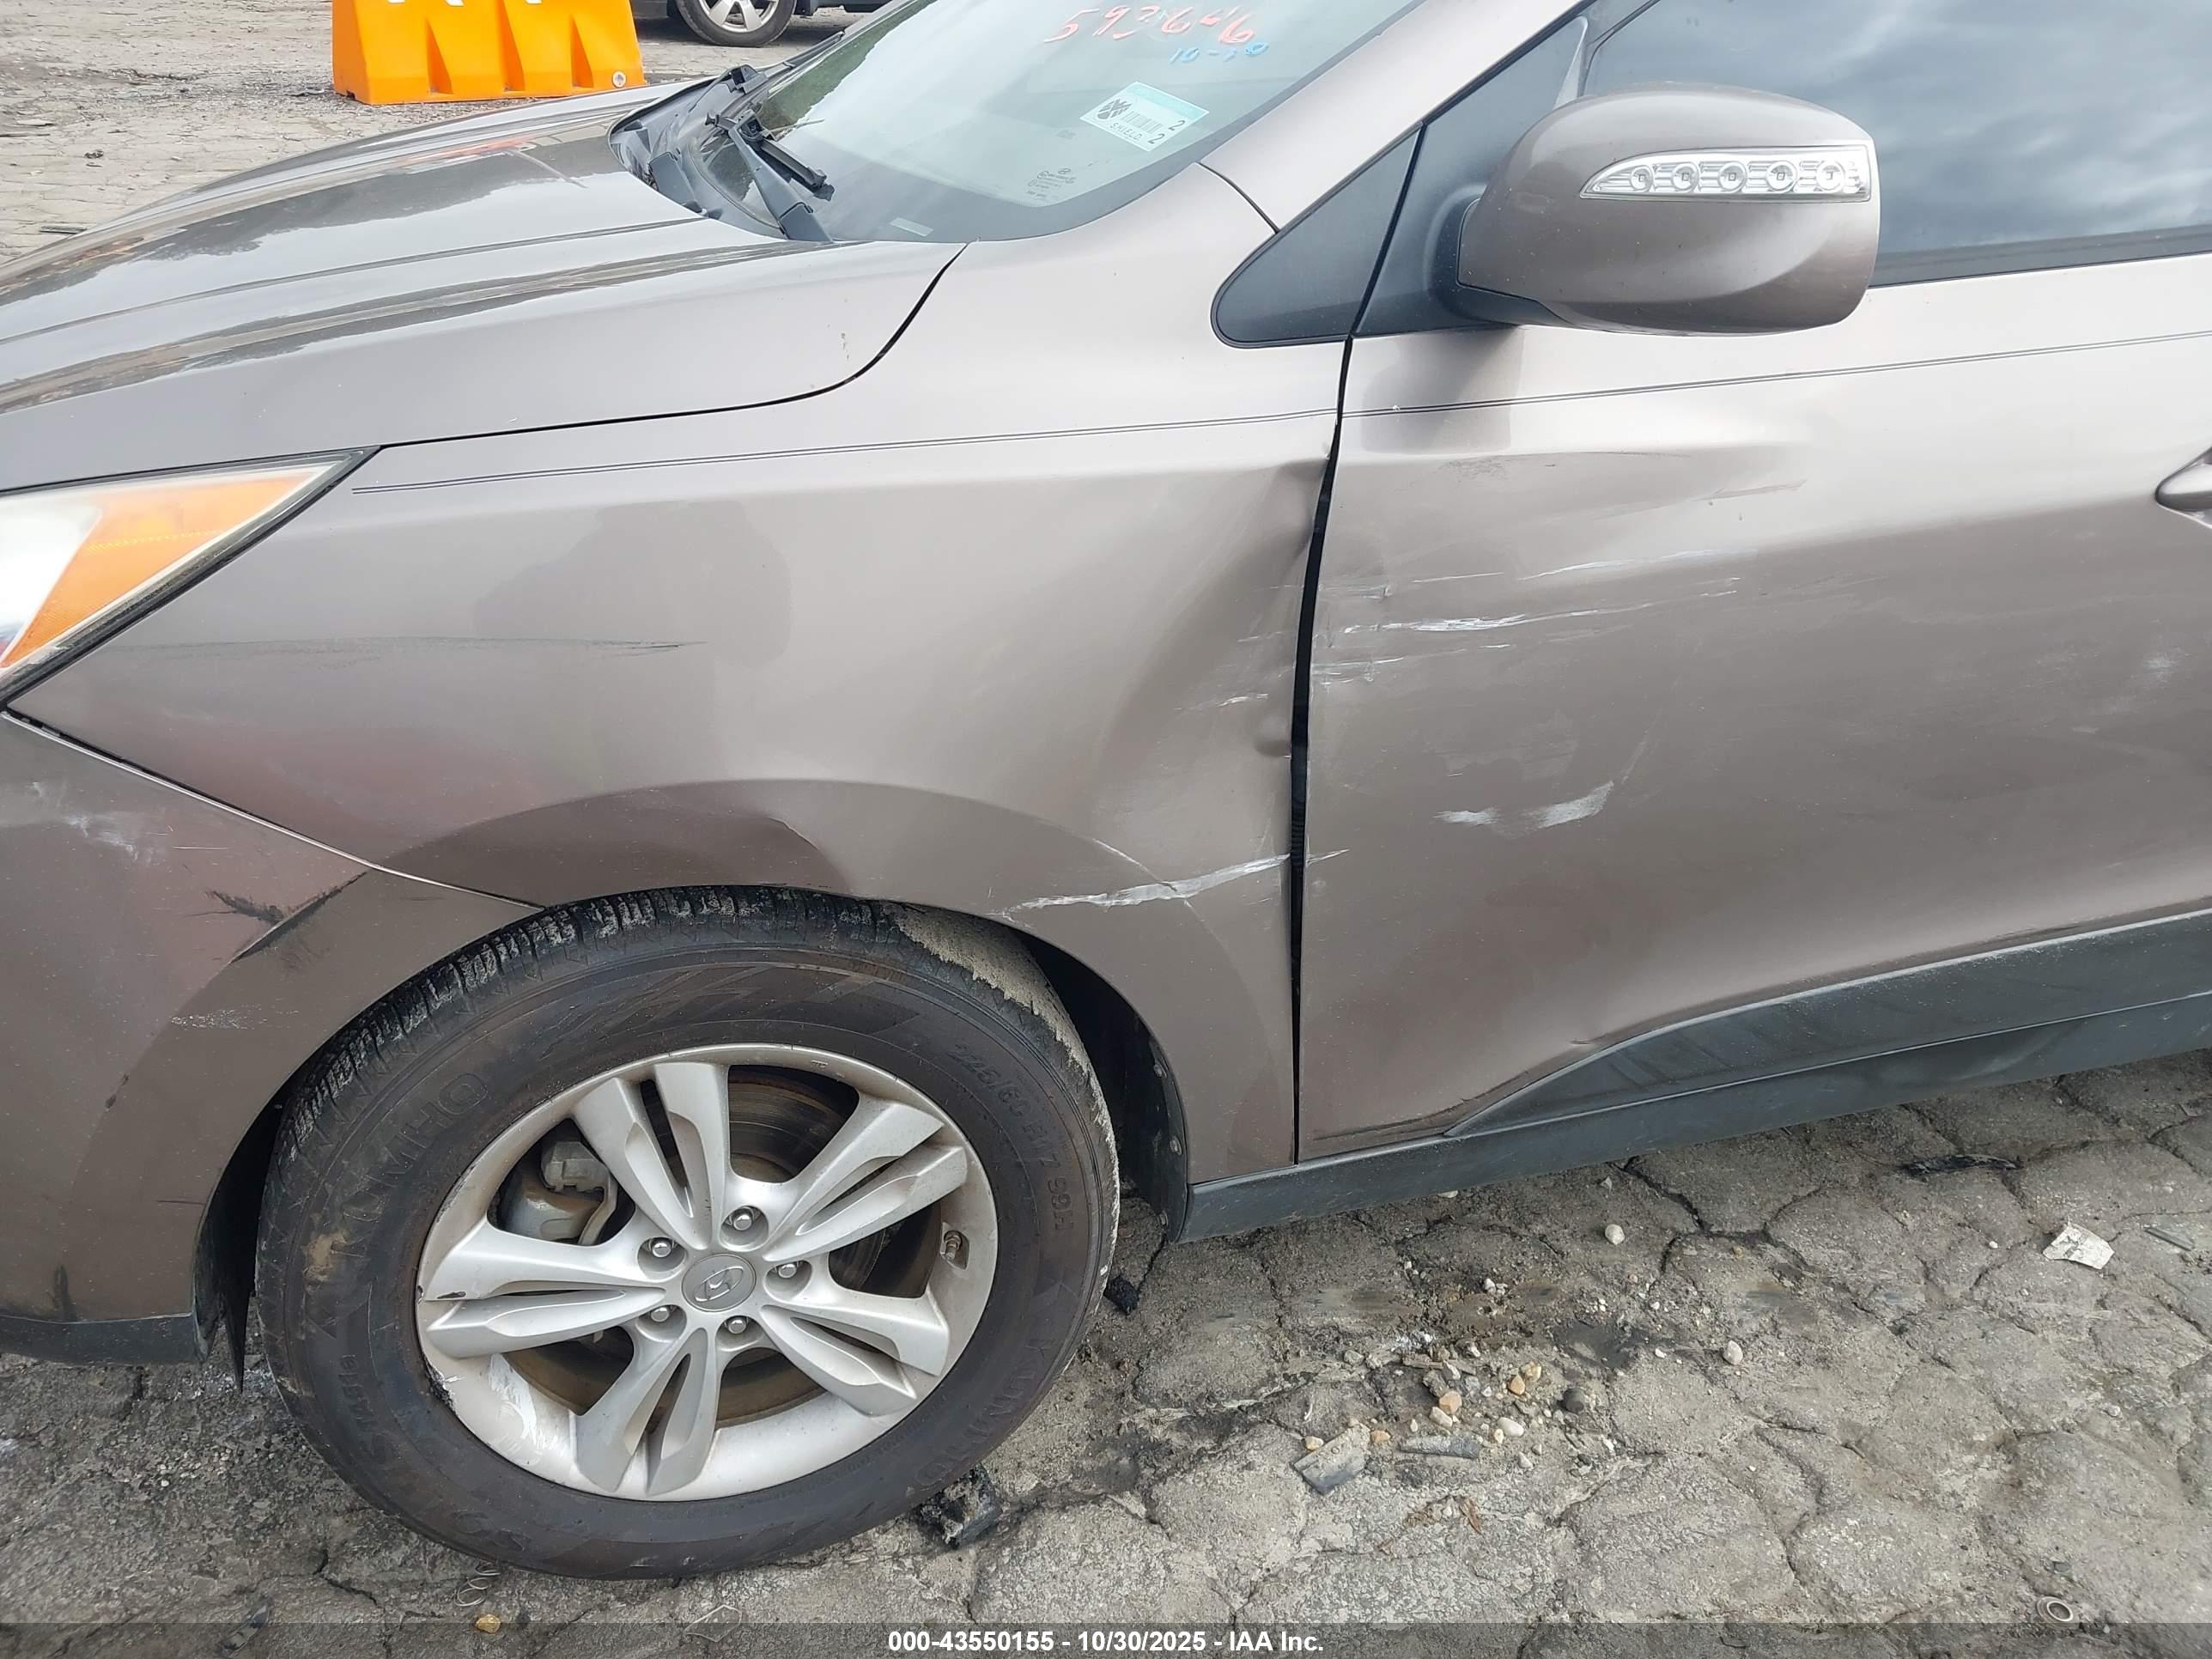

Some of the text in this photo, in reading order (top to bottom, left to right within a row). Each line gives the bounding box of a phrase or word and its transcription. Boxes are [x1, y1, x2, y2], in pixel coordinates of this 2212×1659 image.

[1167, 119, 1186, 131] 2
[1147, 132, 1165, 144] 2
[1046, 1176, 1073, 1231] 99H
